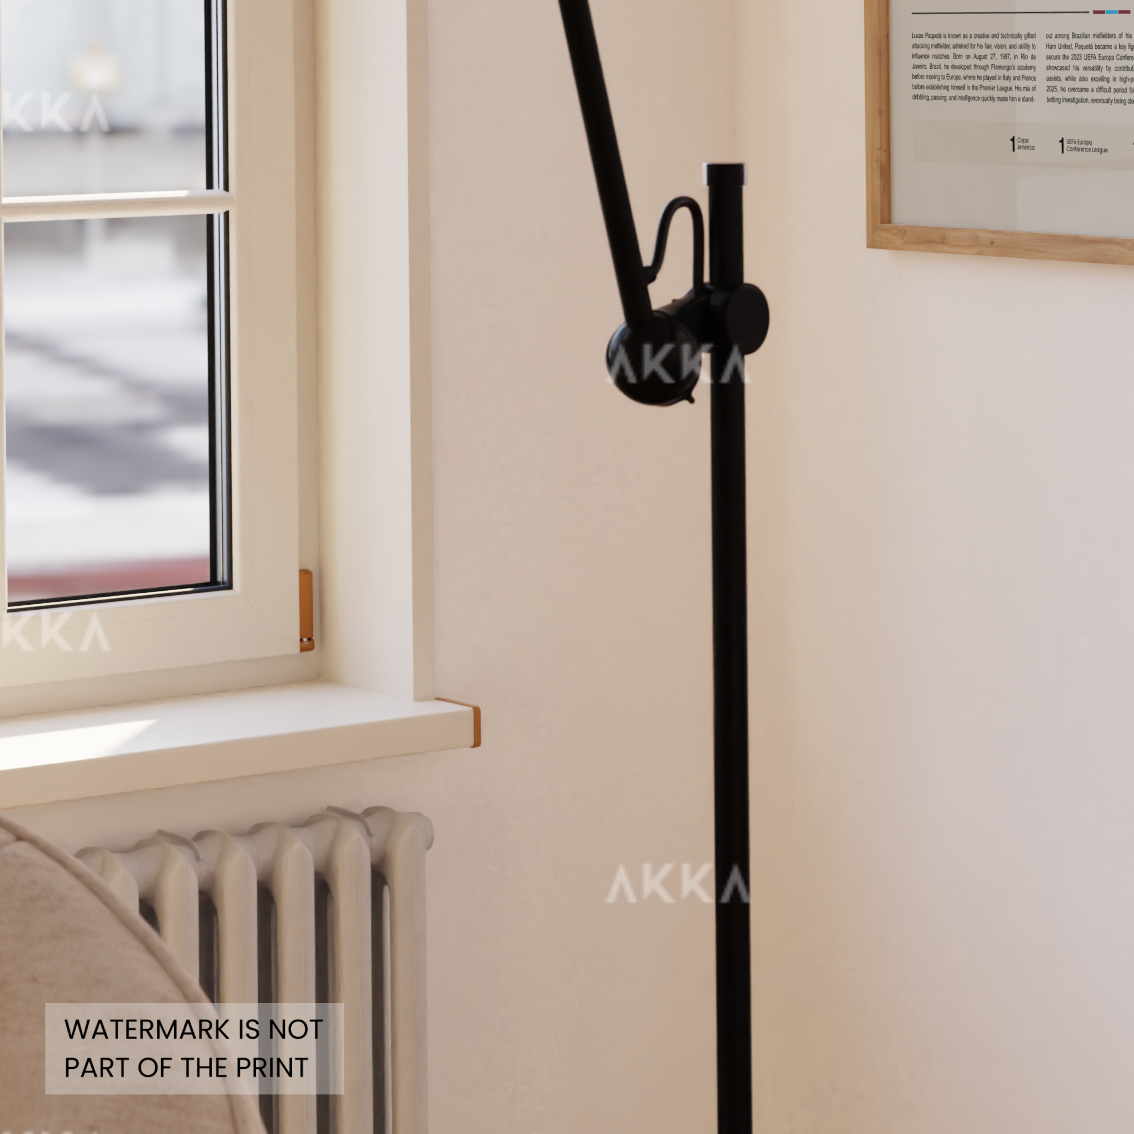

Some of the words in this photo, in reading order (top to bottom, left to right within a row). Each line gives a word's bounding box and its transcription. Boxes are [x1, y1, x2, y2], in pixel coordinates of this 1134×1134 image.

[1010, 135, 1015, 153] 1
[1017, 137, 1029, 145] Copa
[1059, 137, 1064, 154] 1
